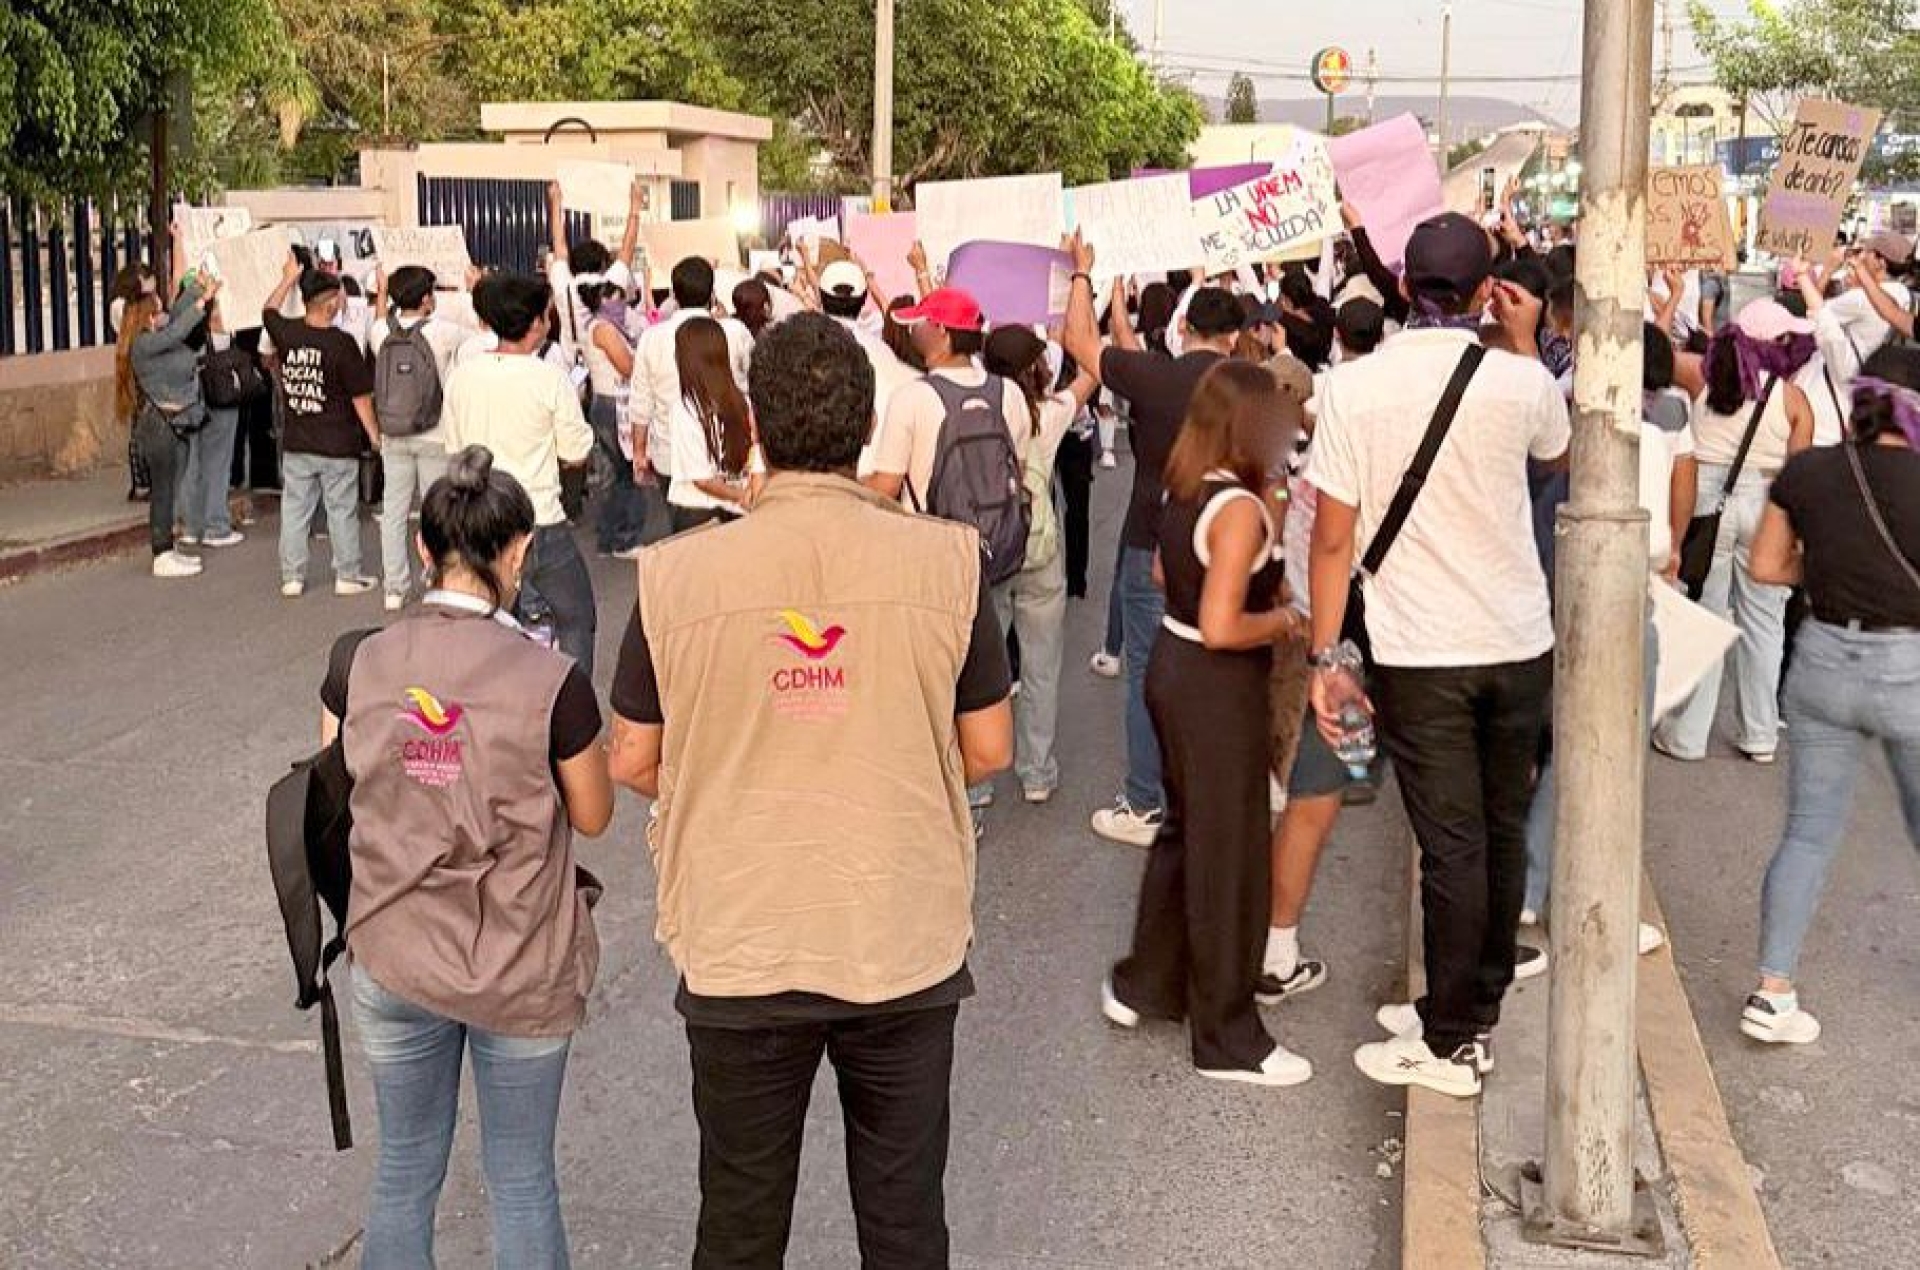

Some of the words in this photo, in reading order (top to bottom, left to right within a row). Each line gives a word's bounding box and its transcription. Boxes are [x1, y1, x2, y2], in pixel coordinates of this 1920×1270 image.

[1215, 190, 1241, 217] LA
[1244, 202, 1280, 232] NO
[1200, 231, 1227, 254] ME
[286, 347, 321, 366] ANTI
[772, 665, 845, 691] CDHM
[402, 738, 460, 761] CDHM
